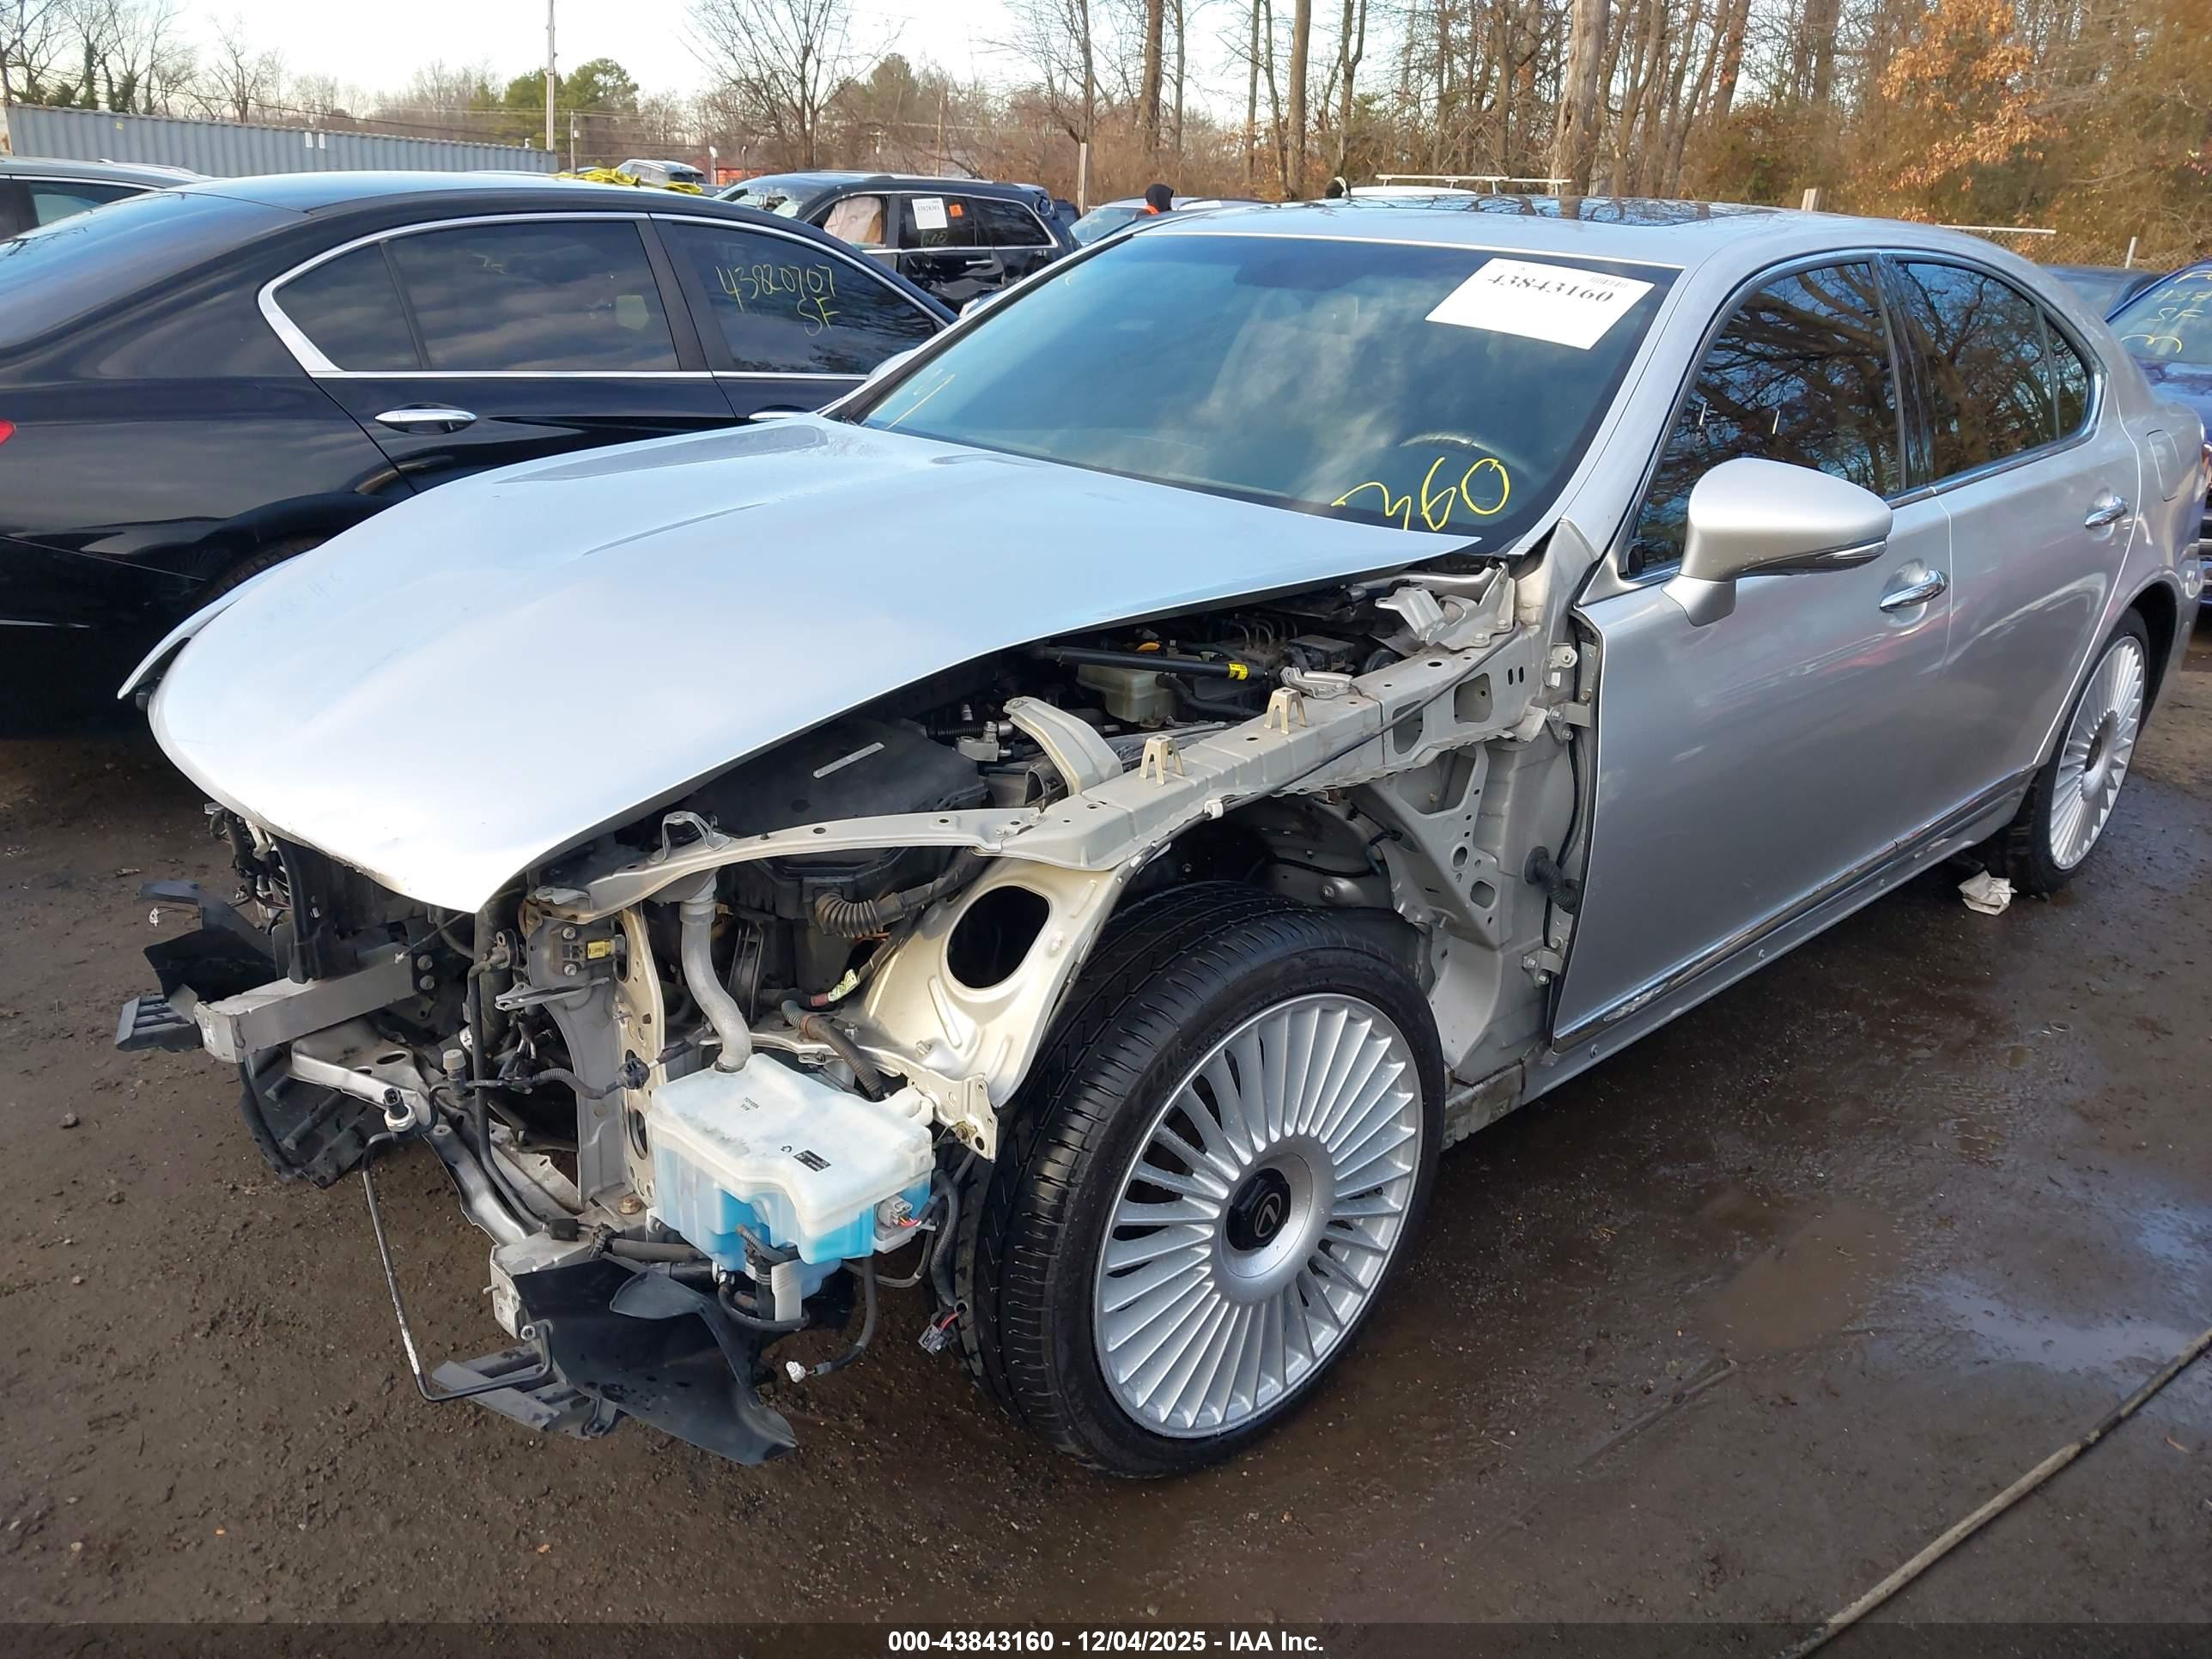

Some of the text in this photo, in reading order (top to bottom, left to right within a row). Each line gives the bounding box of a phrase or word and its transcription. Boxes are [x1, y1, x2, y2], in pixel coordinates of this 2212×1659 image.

[715, 263, 836, 313] 43820707
[1487, 274, 1614, 302] 43843160
[797, 296, 841, 337] SF
